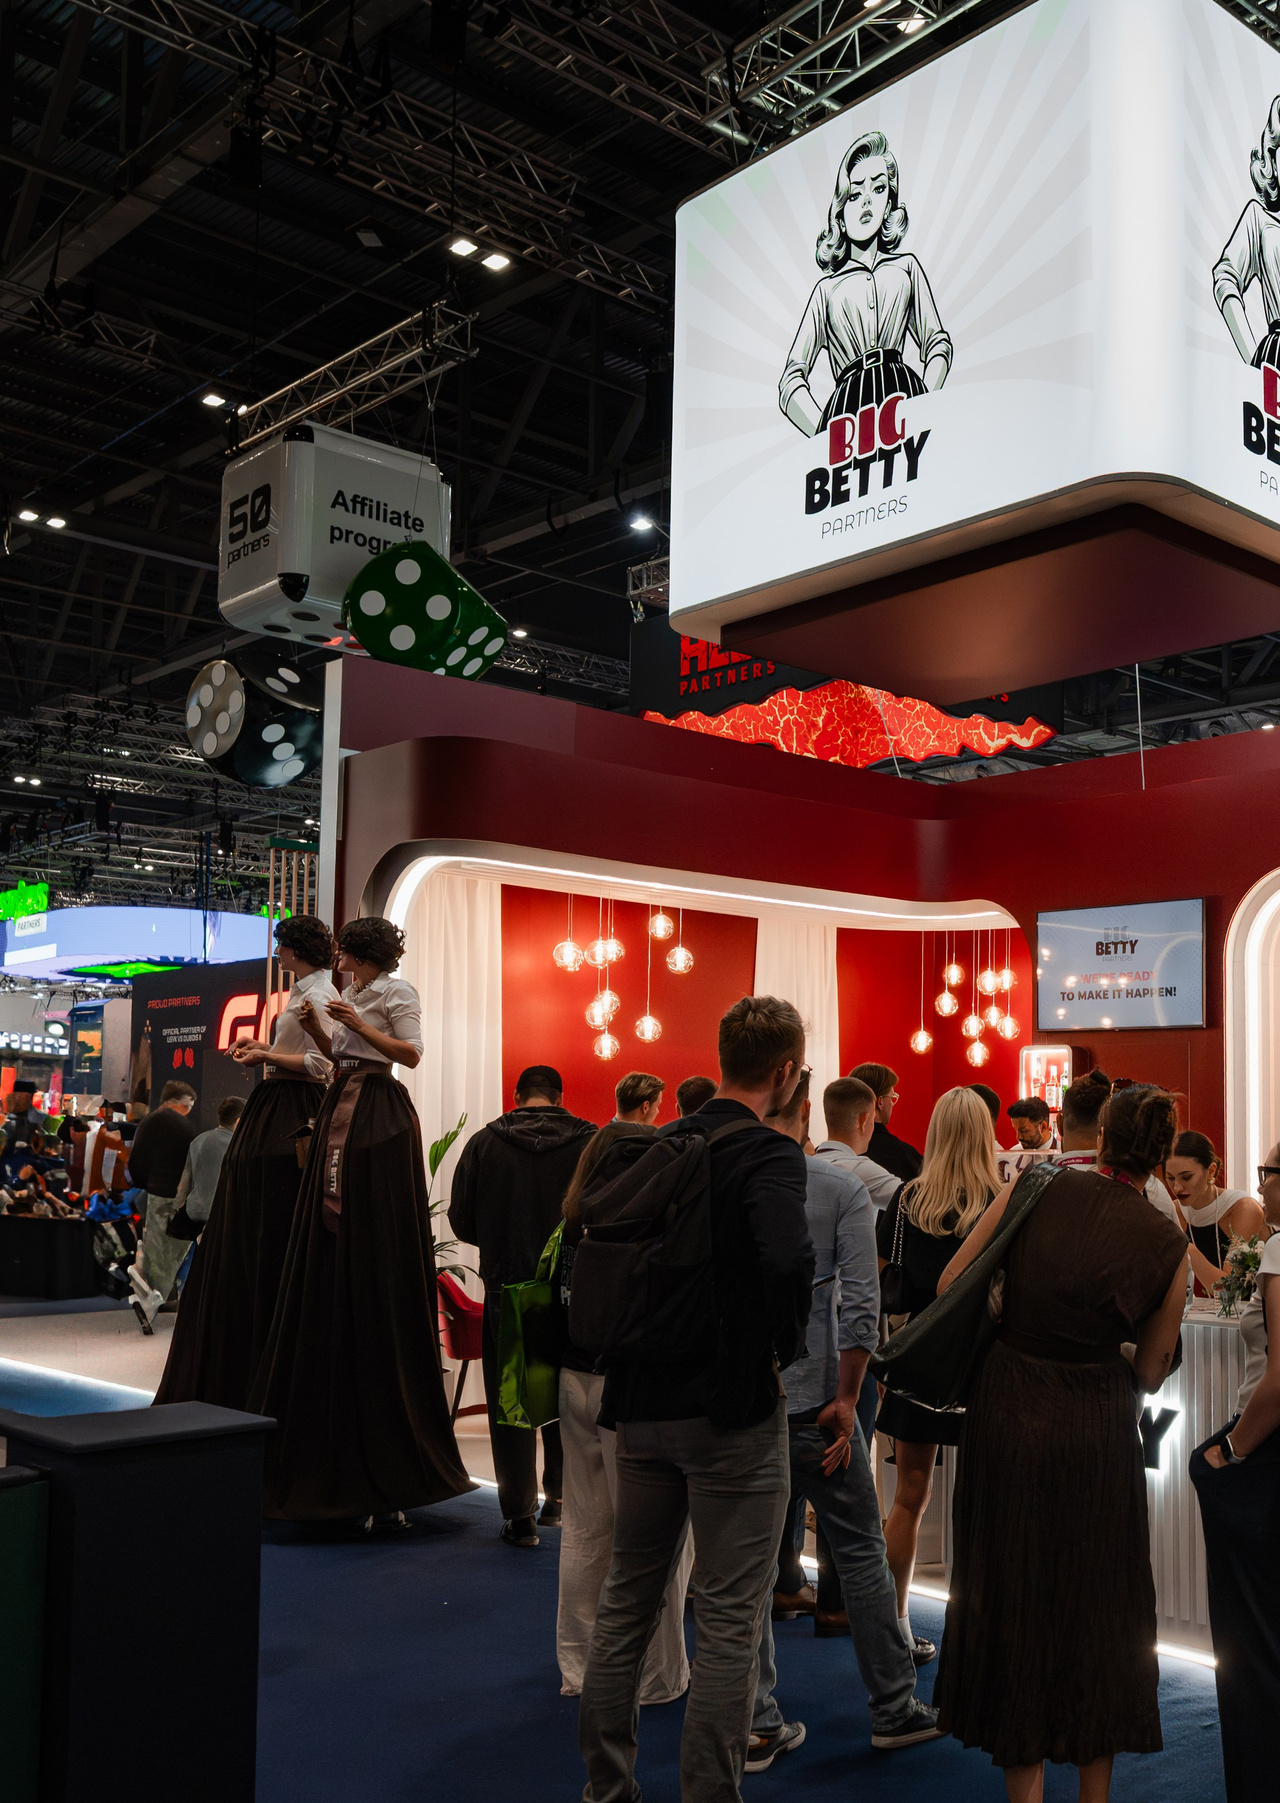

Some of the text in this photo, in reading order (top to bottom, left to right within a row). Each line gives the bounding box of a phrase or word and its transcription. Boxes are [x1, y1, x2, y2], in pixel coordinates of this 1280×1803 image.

[829, 395, 906, 466] BIG
[805, 429, 932, 515] BETTY
[228, 483, 272, 544] 50
[330, 489, 425, 533] Affiliate
[821, 495, 908, 539] PARTNERS
[227, 533, 270, 569] partners
[329, 525, 399, 556] progr
[680, 661, 775, 695] PARTNERS
[1095, 940, 1138, 956] BETTY
[1103, 926, 1130, 941] BIG
[168, 996, 200, 1007] PARTNERS
[1060, 986, 1177, 1001] TO MAKE IT HAPPEN!
